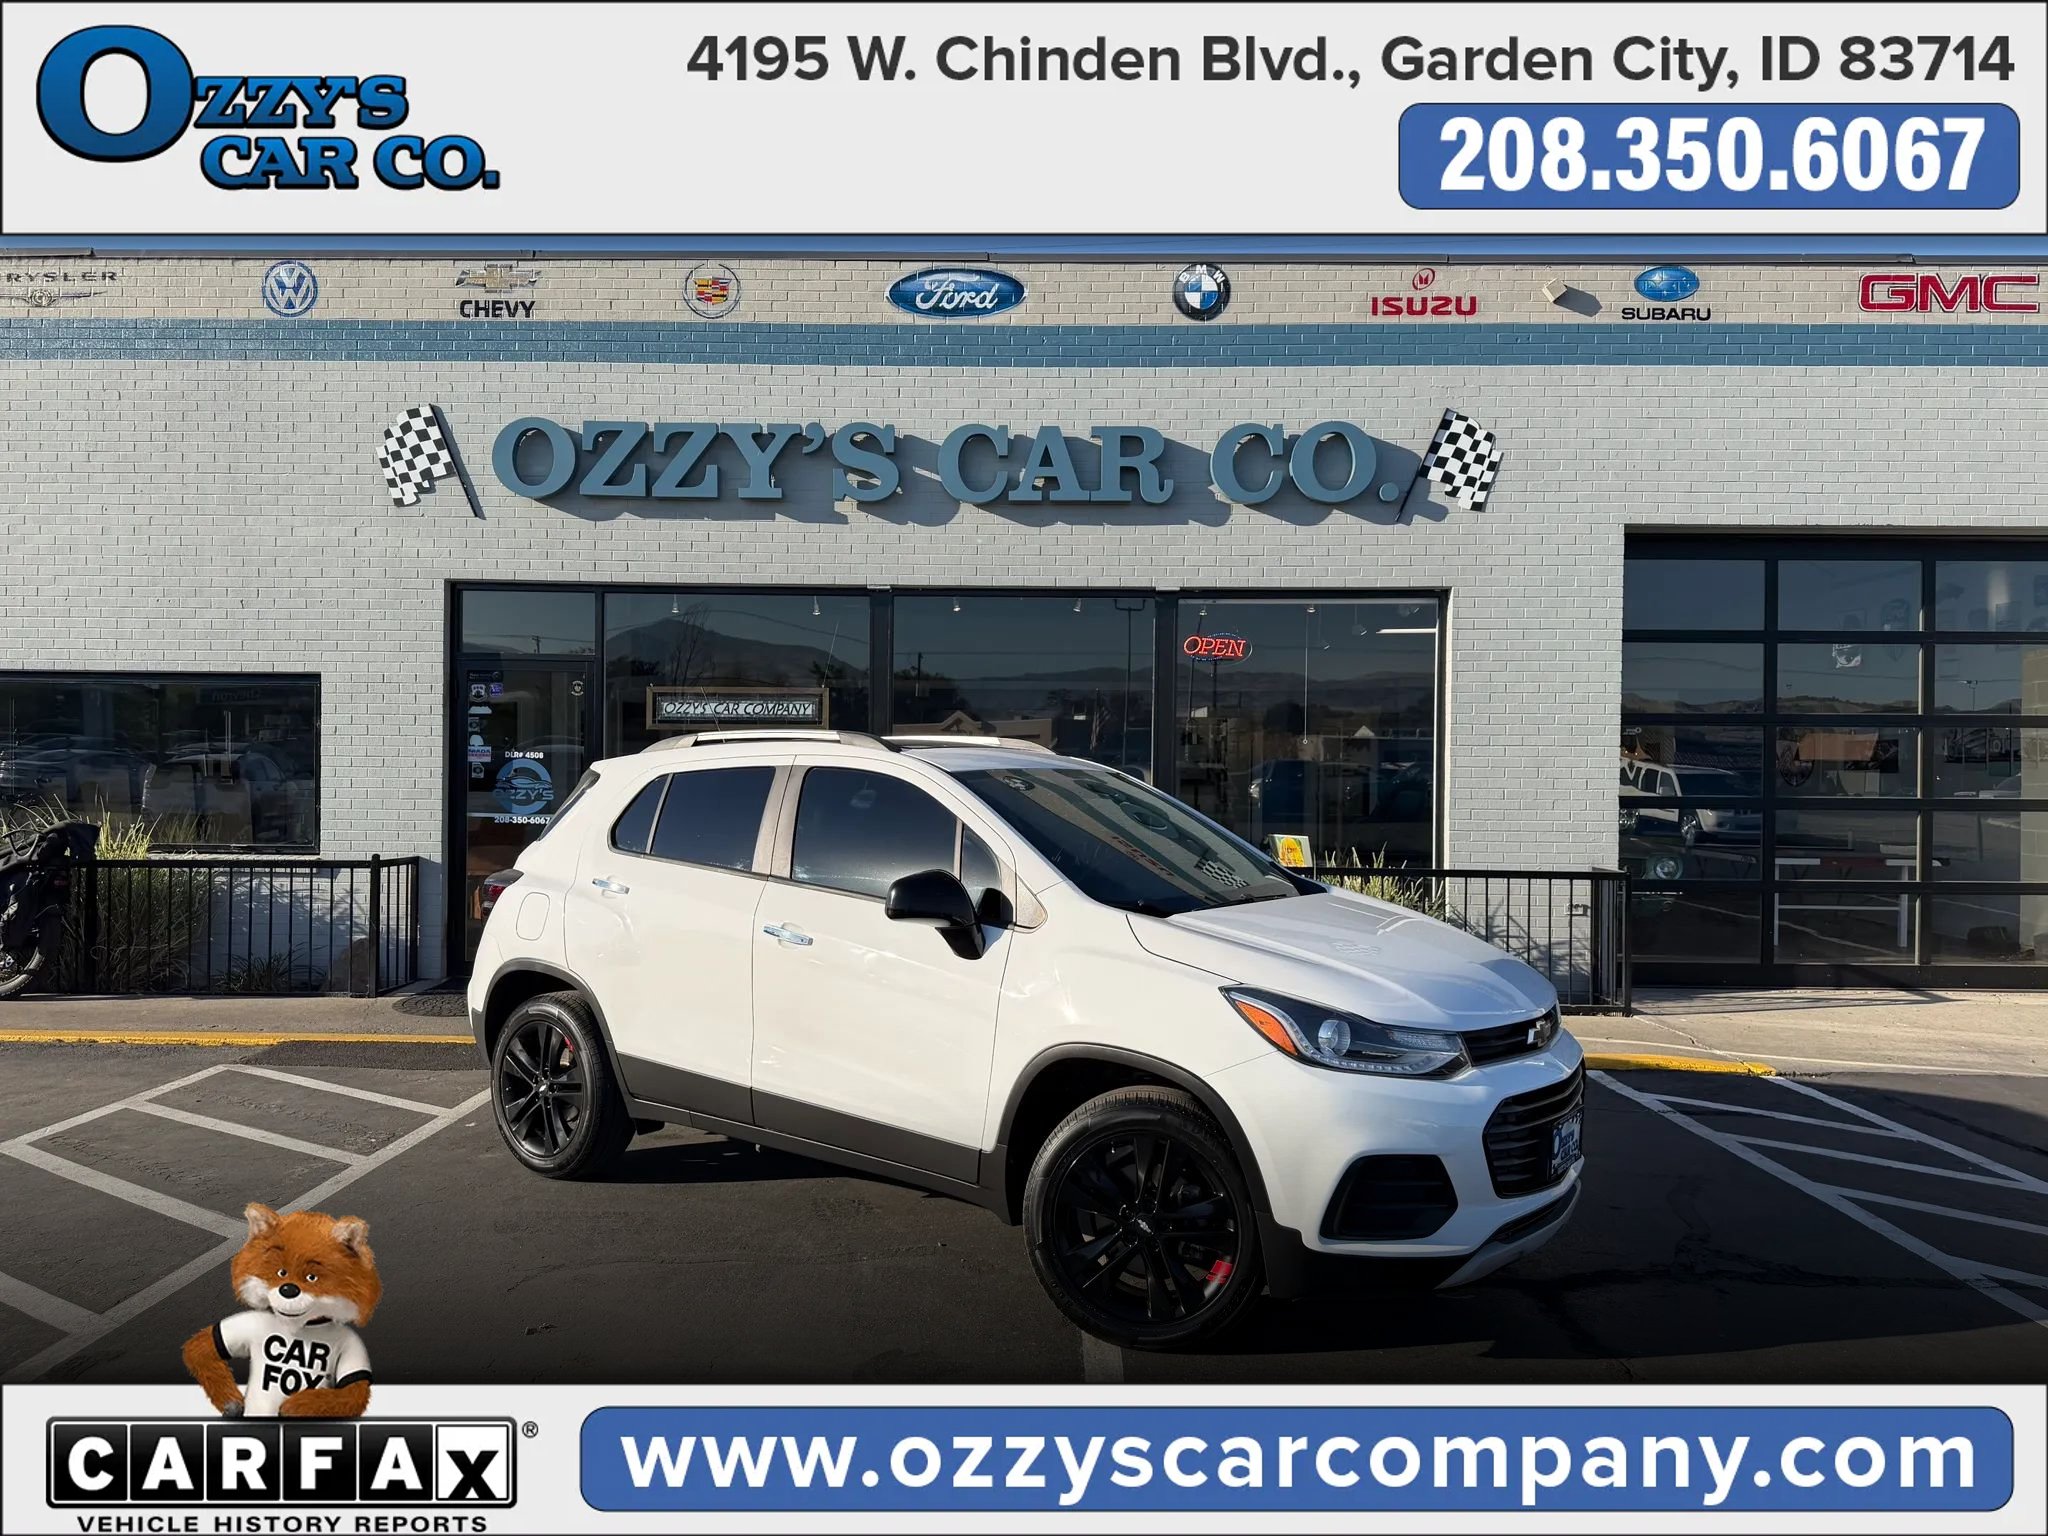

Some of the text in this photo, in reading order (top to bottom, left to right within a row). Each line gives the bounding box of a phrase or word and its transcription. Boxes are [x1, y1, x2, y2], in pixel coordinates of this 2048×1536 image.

[1178, 264, 1226, 284] BMW
[915, 278, 1000, 311] Ford
[1858, 273, 2040, 313] GMC
[459, 299, 536, 319] CHEVY
[1371, 295, 1477, 317] ISUZU
[1621, 307, 1713, 321] SUBARU
[491, 416, 1400, 504] OZZY'S CAR CO.
[1183, 635, 1247, 657] OPEN
[713, 703, 739, 715] CAR
[744, 703, 812, 716] COMPANY
